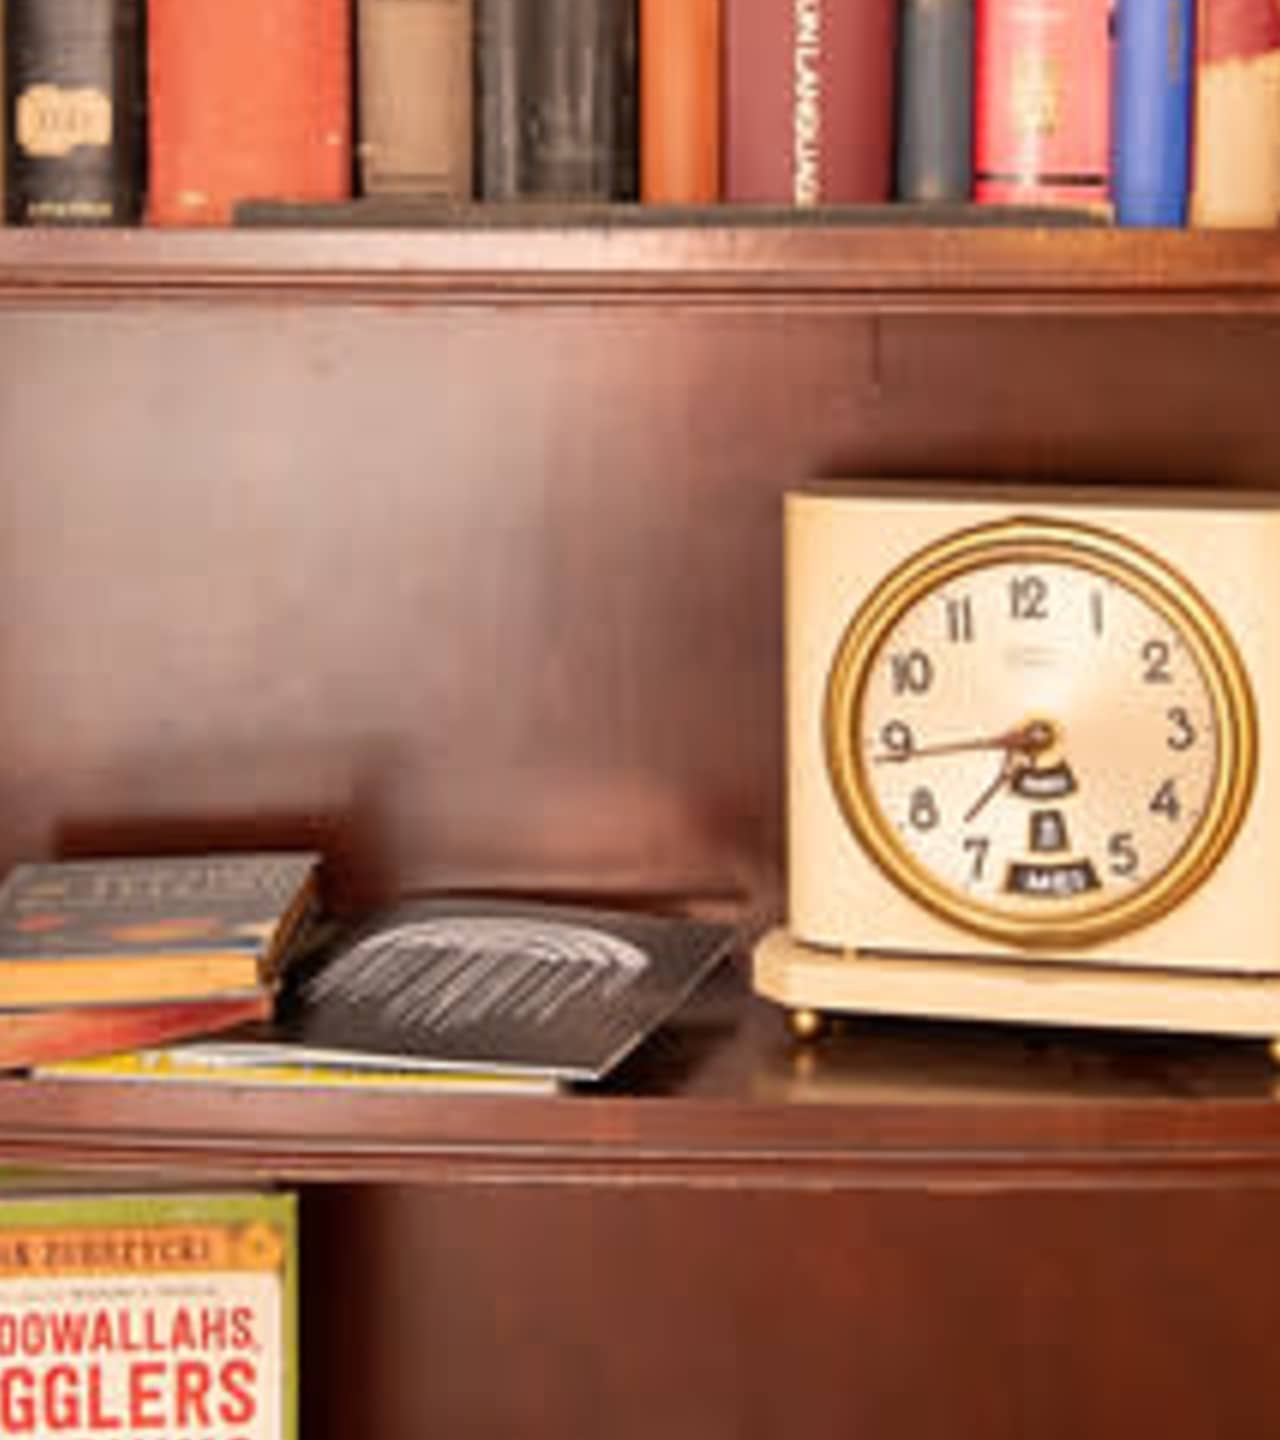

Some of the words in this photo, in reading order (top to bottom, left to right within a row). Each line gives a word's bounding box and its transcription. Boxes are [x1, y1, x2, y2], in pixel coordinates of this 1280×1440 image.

[793, 46, 821, 209] LANGUAG
[1008, 574, 1049, 619] 12
[1091, 588, 1104, 635] 1
[946, 595, 975, 644] 11
[891, 650, 935, 696] 10
[1141, 639, 1173, 684] 2
[880, 720, 913, 763] 9
[1167, 710, 1196, 752] 3
[908, 785, 940, 830] 8
[1148, 779, 1181, 819] 4
[963, 837, 990, 882] 7
[1108, 832, 1140, 875] 5
